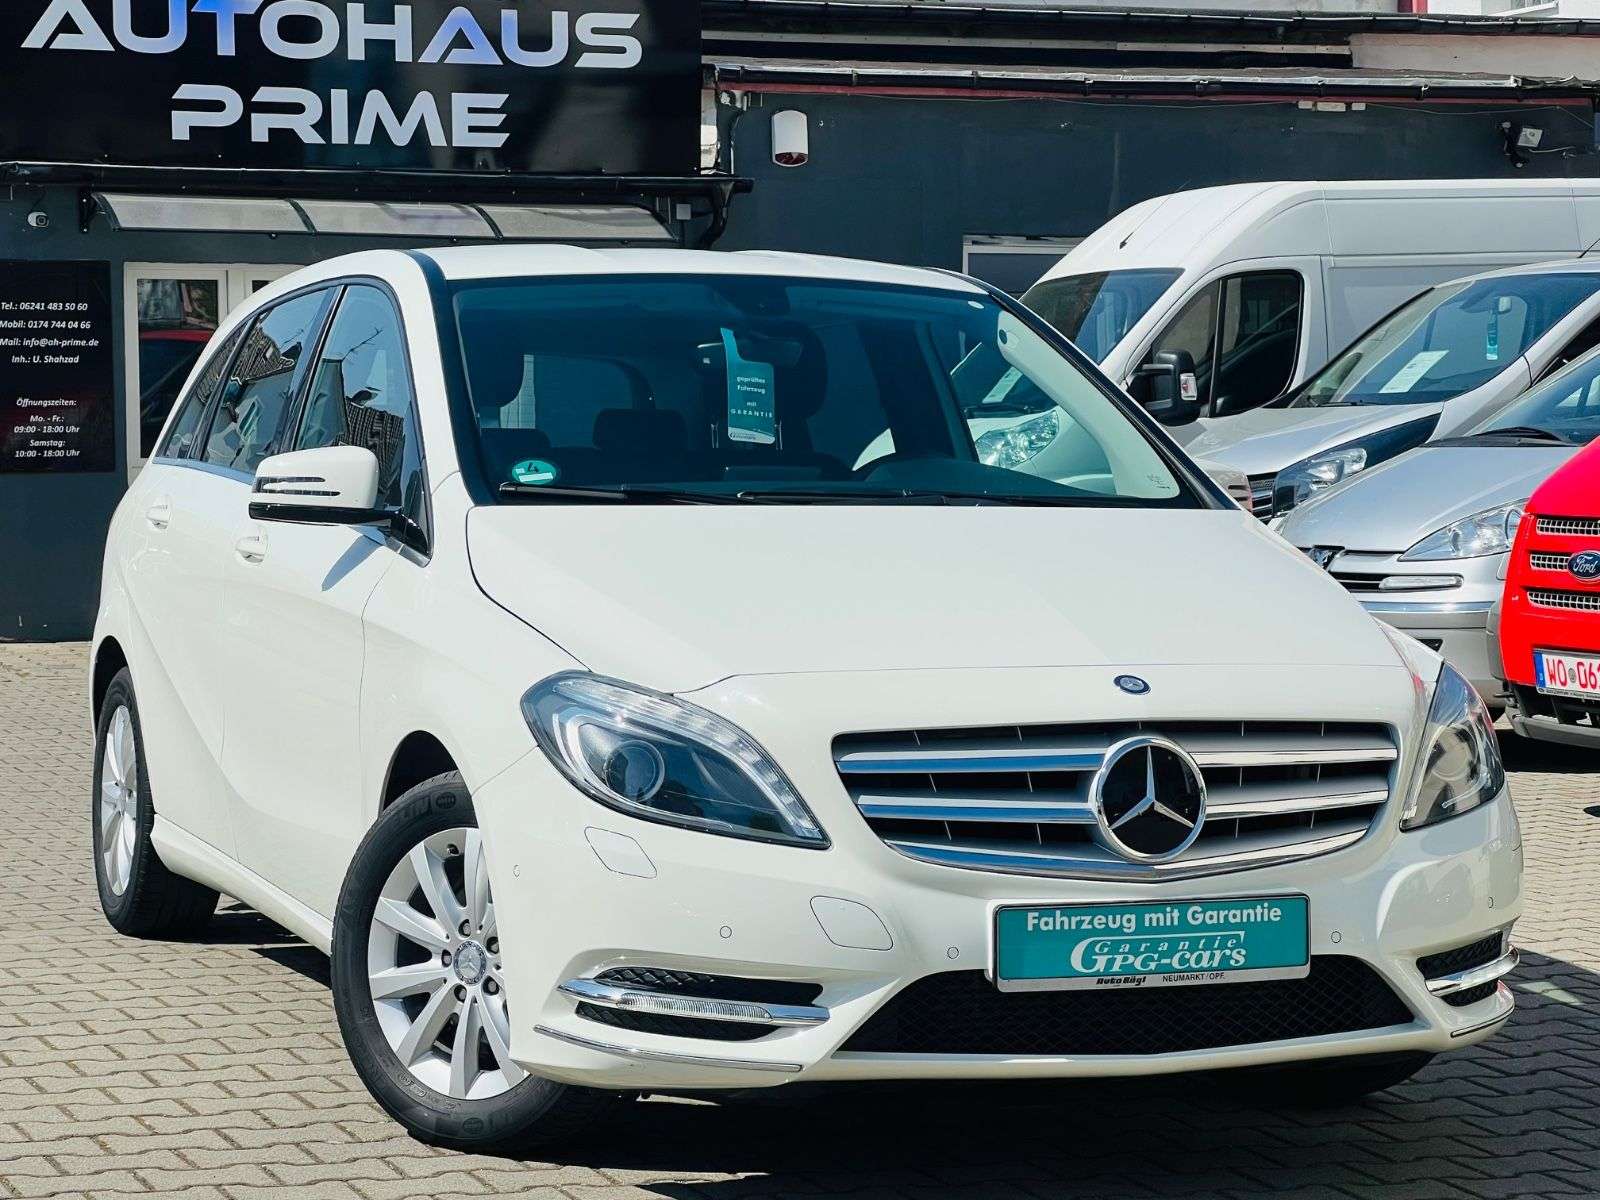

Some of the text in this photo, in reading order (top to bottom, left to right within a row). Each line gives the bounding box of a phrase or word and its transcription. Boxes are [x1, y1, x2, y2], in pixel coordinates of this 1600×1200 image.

[20, 0, 643, 69] AUTOHAUS
[171, 83, 511, 148] PRIME
[1, 301, 88, 311] Tel.: 06241 483 50 60
[0, 320, 91, 329] Mobil: 0174 744 04 66
[22, 338, 99, 348] info@ah-prime.de
[11, 355, 80, 363] Inh.: U. Shahzad
[16, 397, 77, 408] Öffnungszeiten:
[29, 414, 46, 422] Mo.
[13, 425, 37, 433] 09:00
[42, 425, 65, 433] 18:00
[65, 425, 80, 433] Uhr
[29, 439, 66, 448] Samstag:
[15, 450, 37, 458] 10:00
[66, 449, 80, 457] Uhr
[527, 462, 539, 473] 4
[1573, 555, 1599, 574] Ford
[1546, 658, 1568, 687] WO
[1026, 902, 1282, 933] Fahrzeug mit Garantie
[1094, 936, 1237, 953] Garantie
